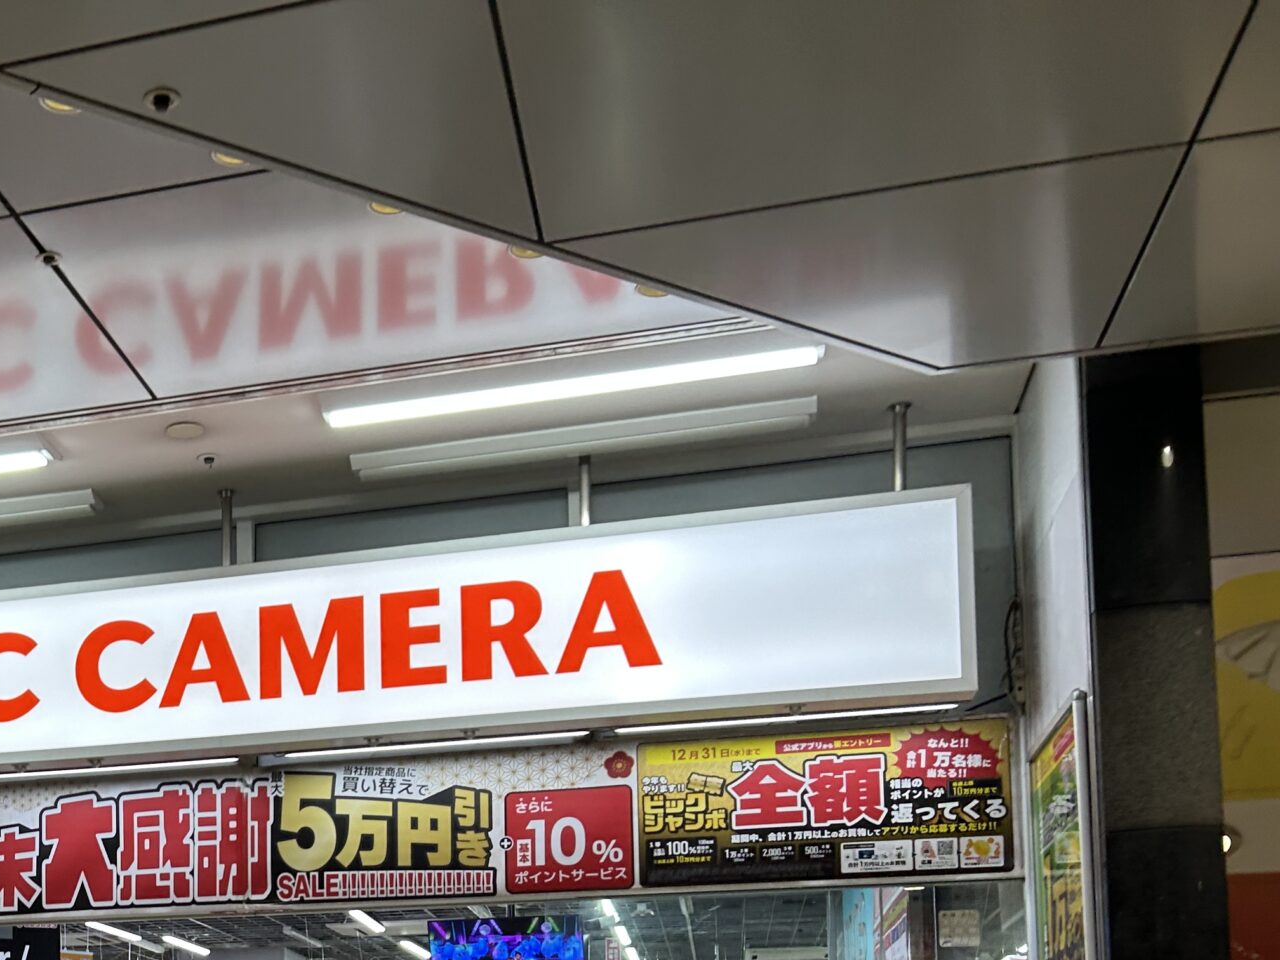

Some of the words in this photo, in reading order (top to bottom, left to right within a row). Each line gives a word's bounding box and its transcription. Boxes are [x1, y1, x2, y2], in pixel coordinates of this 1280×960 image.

[74, 569, 662, 712] CAMERA
[671, 745, 761, 761] 12月31日(水)まで
[927, 737, 969, 749] なんと!!
[343, 765, 417, 779] 当社指定商品に
[926, 767, 968, 779] 当たる!!
[341, 776, 429, 797] 買い替えで
[728, 753, 888, 830] 全額
[890, 778, 922, 790] 相当の
[890, 787, 946, 799] ポイントが
[514, 799, 553, 813] さらに
[643, 793, 708, 814] ビック
[890, 798, 1007, 825] 返ってくる
[276, 772, 492, 871] 5万円引き
[644, 808, 727, 834] ジャンボ
[525, 816, 624, 867] 10%
[518, 842, 531, 867] 基本
[513, 867, 628, 885] ポイントサービス
